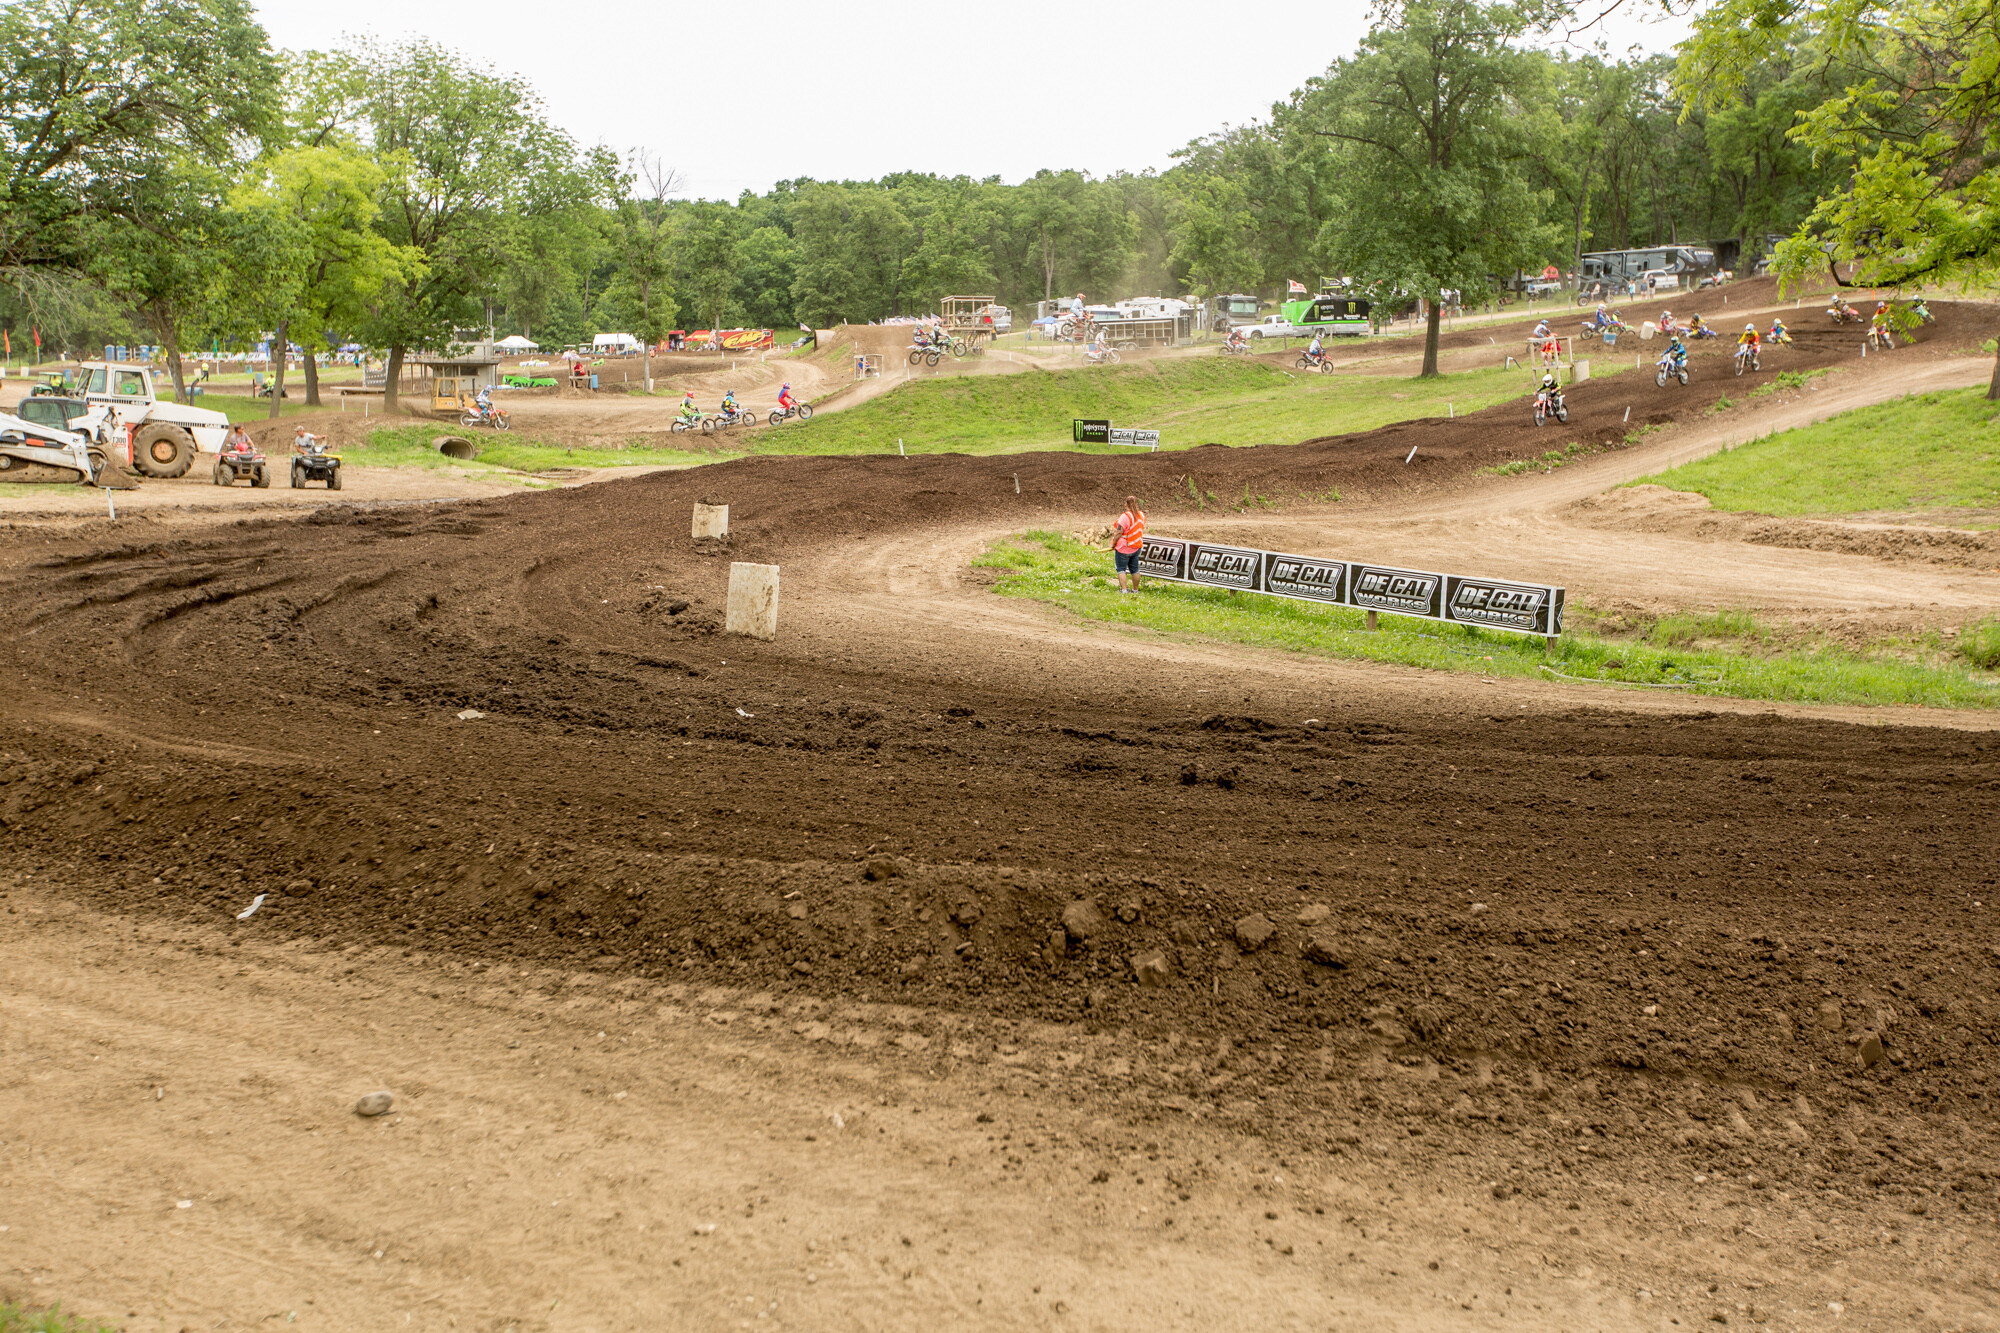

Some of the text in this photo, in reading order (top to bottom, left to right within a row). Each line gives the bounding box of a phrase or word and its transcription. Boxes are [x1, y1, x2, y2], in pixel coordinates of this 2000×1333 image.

[1138, 543, 1179, 563] ECAL
[1138, 561, 1175, 572] ORKS
[1197, 552, 1254, 574] DECAL
[1195, 568, 1250, 584] WORKS
[1274, 563, 1338, 587] DECAL
[1271, 580, 1333, 596] WORKS
[1360, 574, 1432, 600] DECAL
[1357, 592, 1427, 610] WORKS
[1458, 586, 1539, 613] DECAL
[1454, 606, 1532, 625] WORKS
